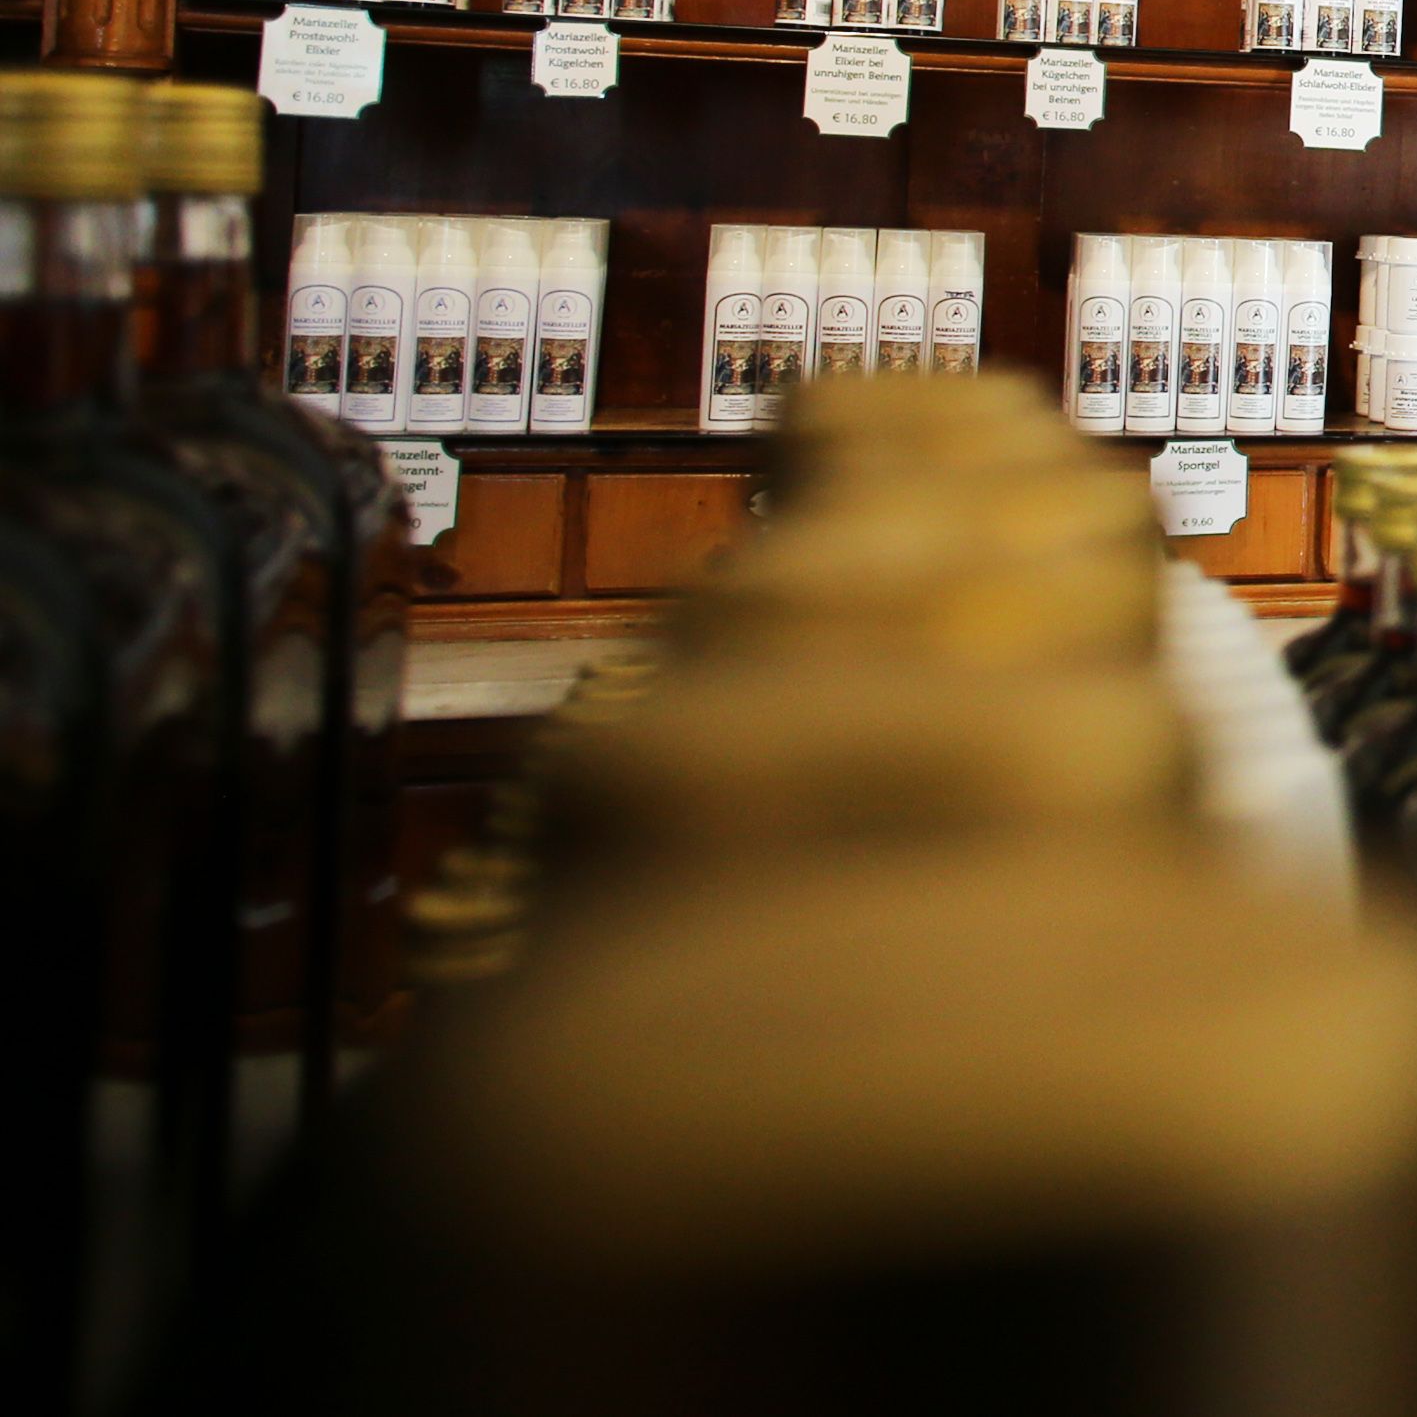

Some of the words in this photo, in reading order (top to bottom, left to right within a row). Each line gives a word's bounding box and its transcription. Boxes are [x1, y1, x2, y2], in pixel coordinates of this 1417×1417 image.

[293, 16, 358, 30] Mariazeller
[289, 29, 358, 43] Prostawohl-
[548, 32, 607, 43] Mariazeller
[306, 45, 341, 56] Elixier
[545, 45, 609, 56] Prostawohl-
[832, 44, 888, 55] Mariazeller
[549, 59, 604, 71] Kügelchen
[835, 57, 865, 68] Elixier
[869, 58, 884, 68] bei
[1040, 57, 1093, 68] Mariazeller
[814, 69, 865, 81] unruhigen
[868, 71, 902, 81] Beinen
[1042, 71, 1090, 82] Kügelchen
[1314, 69, 1363, 80] Mariazeller
[1032, 81, 1047, 91] bei
[1050, 83, 1098, 94] unruhigen
[1298, 79, 1376, 92] Schlafwohl-Elixier
[1048, 95, 1080, 105] Beinen
[1170, 445, 1228, 454] Mariazeller
[1178, 460, 1220, 473] Sportgel
